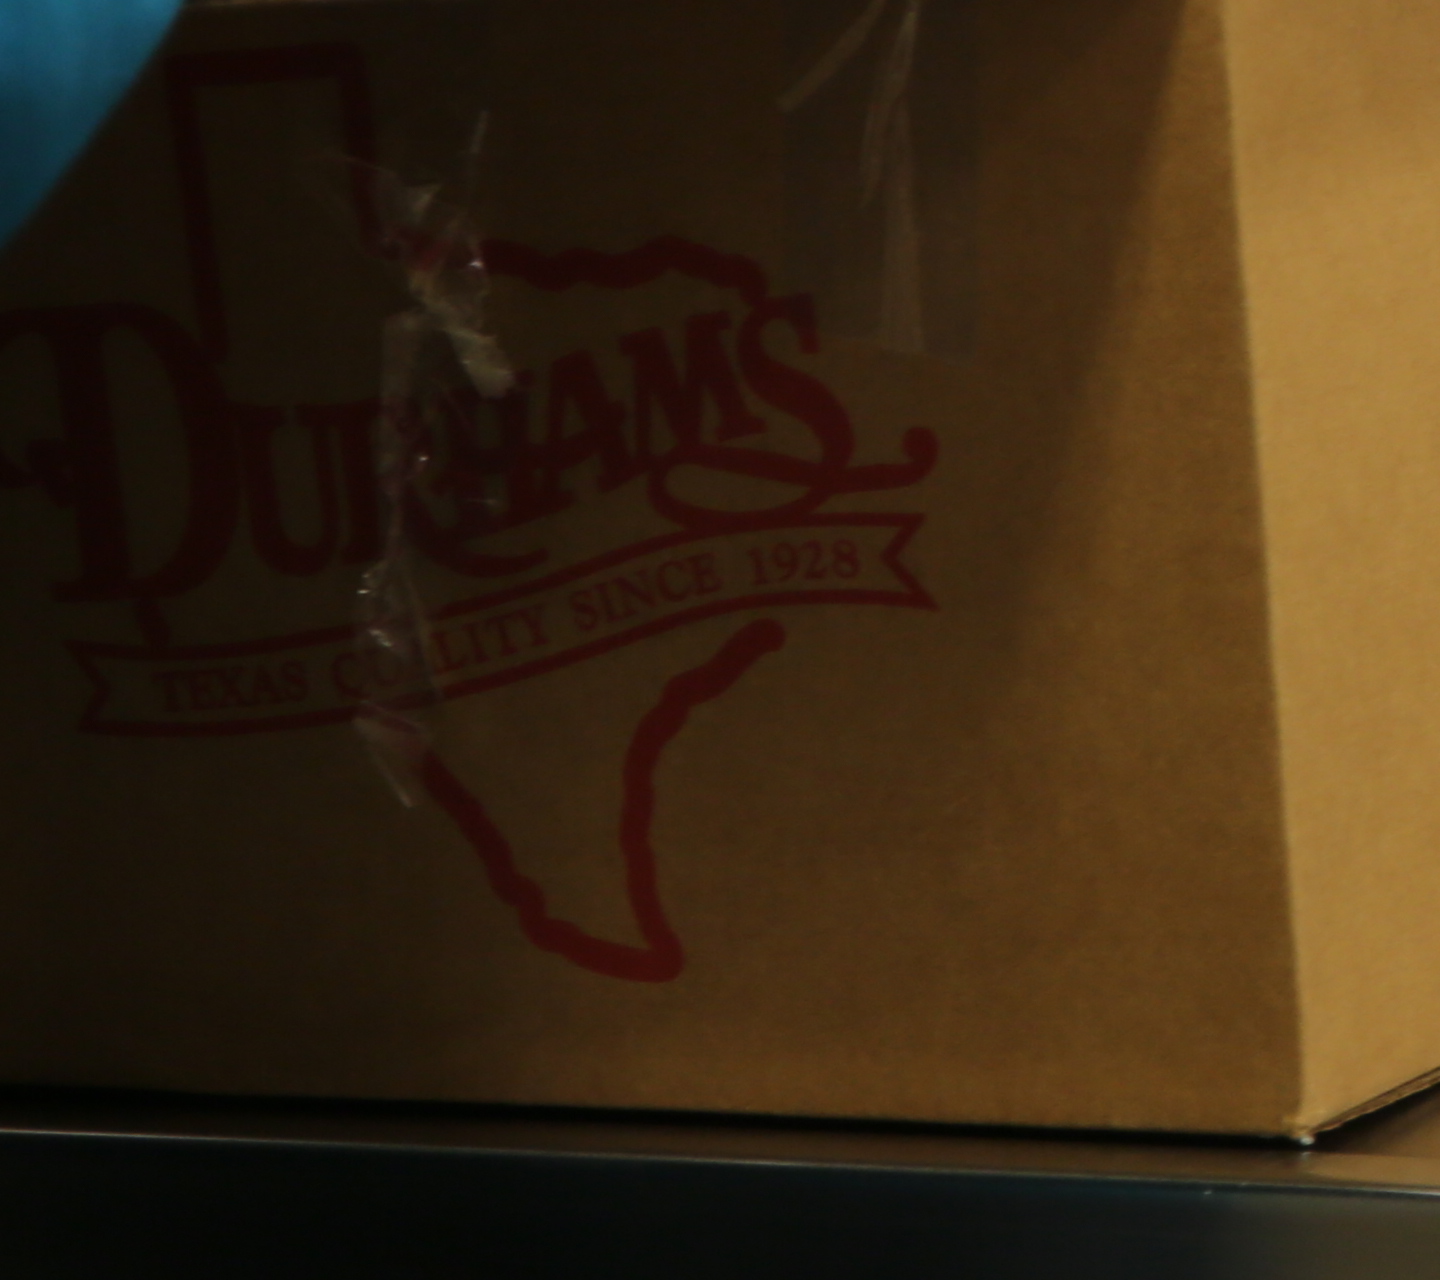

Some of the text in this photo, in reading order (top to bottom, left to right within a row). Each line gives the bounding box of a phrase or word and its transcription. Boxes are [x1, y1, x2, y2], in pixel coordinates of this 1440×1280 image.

[152, 662, 308, 714] TEXAS
[570, 552, 724, 632] SINCE
[749, 540, 862, 586] 1928
